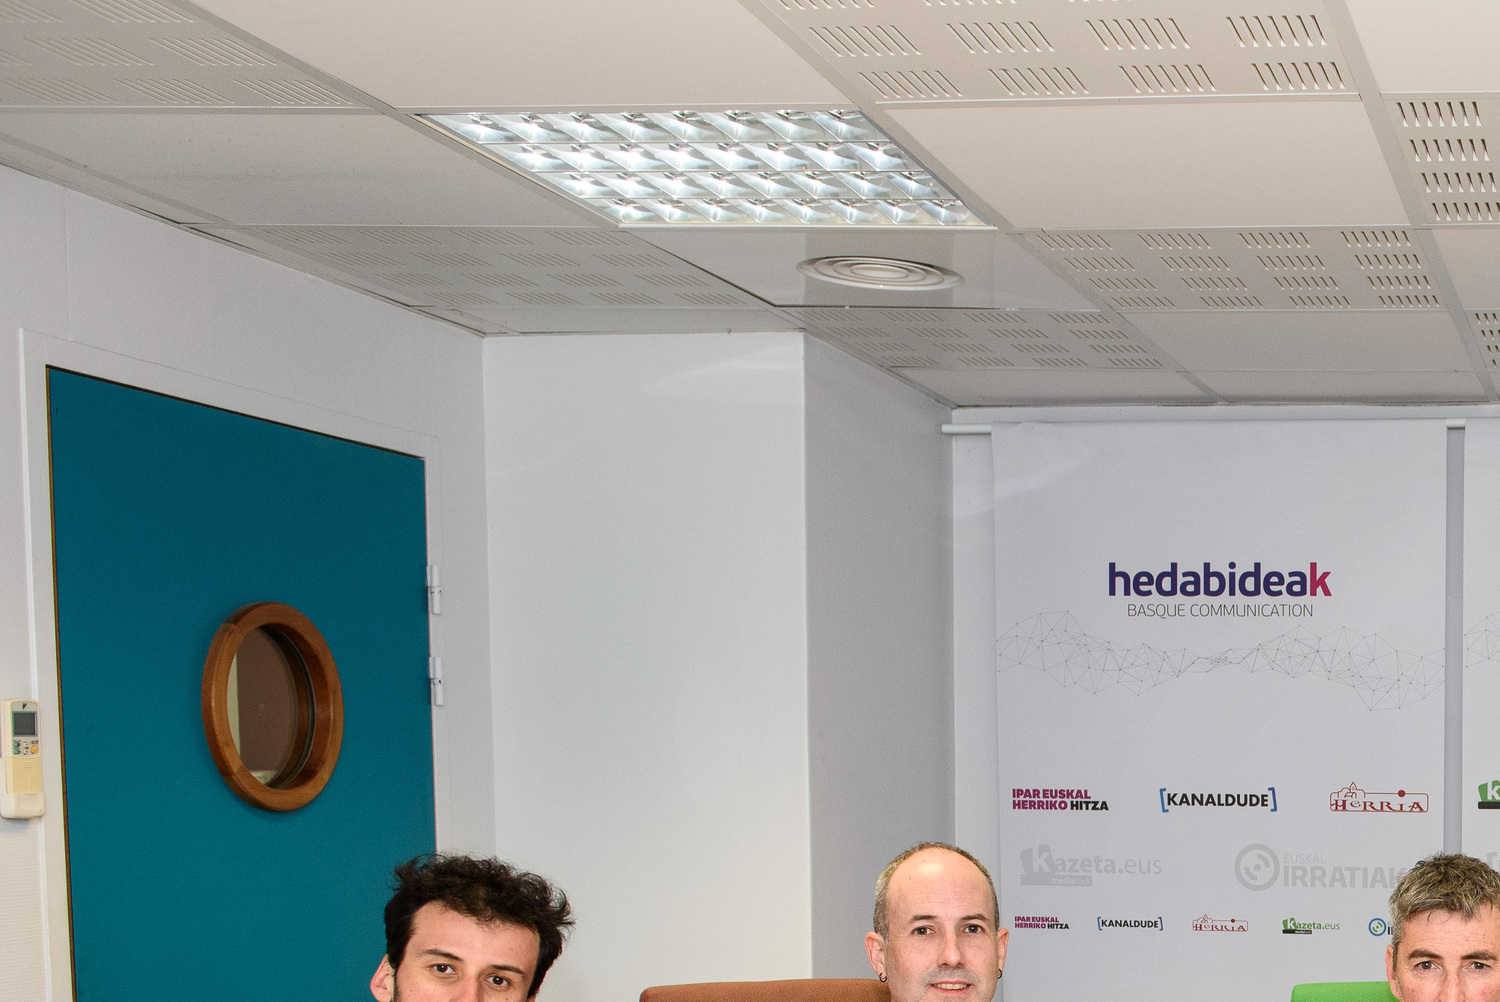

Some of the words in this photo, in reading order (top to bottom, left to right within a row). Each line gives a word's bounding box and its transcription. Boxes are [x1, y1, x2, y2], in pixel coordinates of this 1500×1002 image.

[1109, 561, 1332, 597] hedabideak
[1128, 604, 1185, 619] BASQUE
[1190, 604, 1313, 617] COMMUNICATION
[1012, 789, 1040, 798] IPAR
[1042, 790, 1091, 799] EUSKAL
[1013, 800, 1068, 810] HERRIKO
[1070, 801, 1109, 811] HITZA
[1284, 853, 1326, 864] EUSKAL
